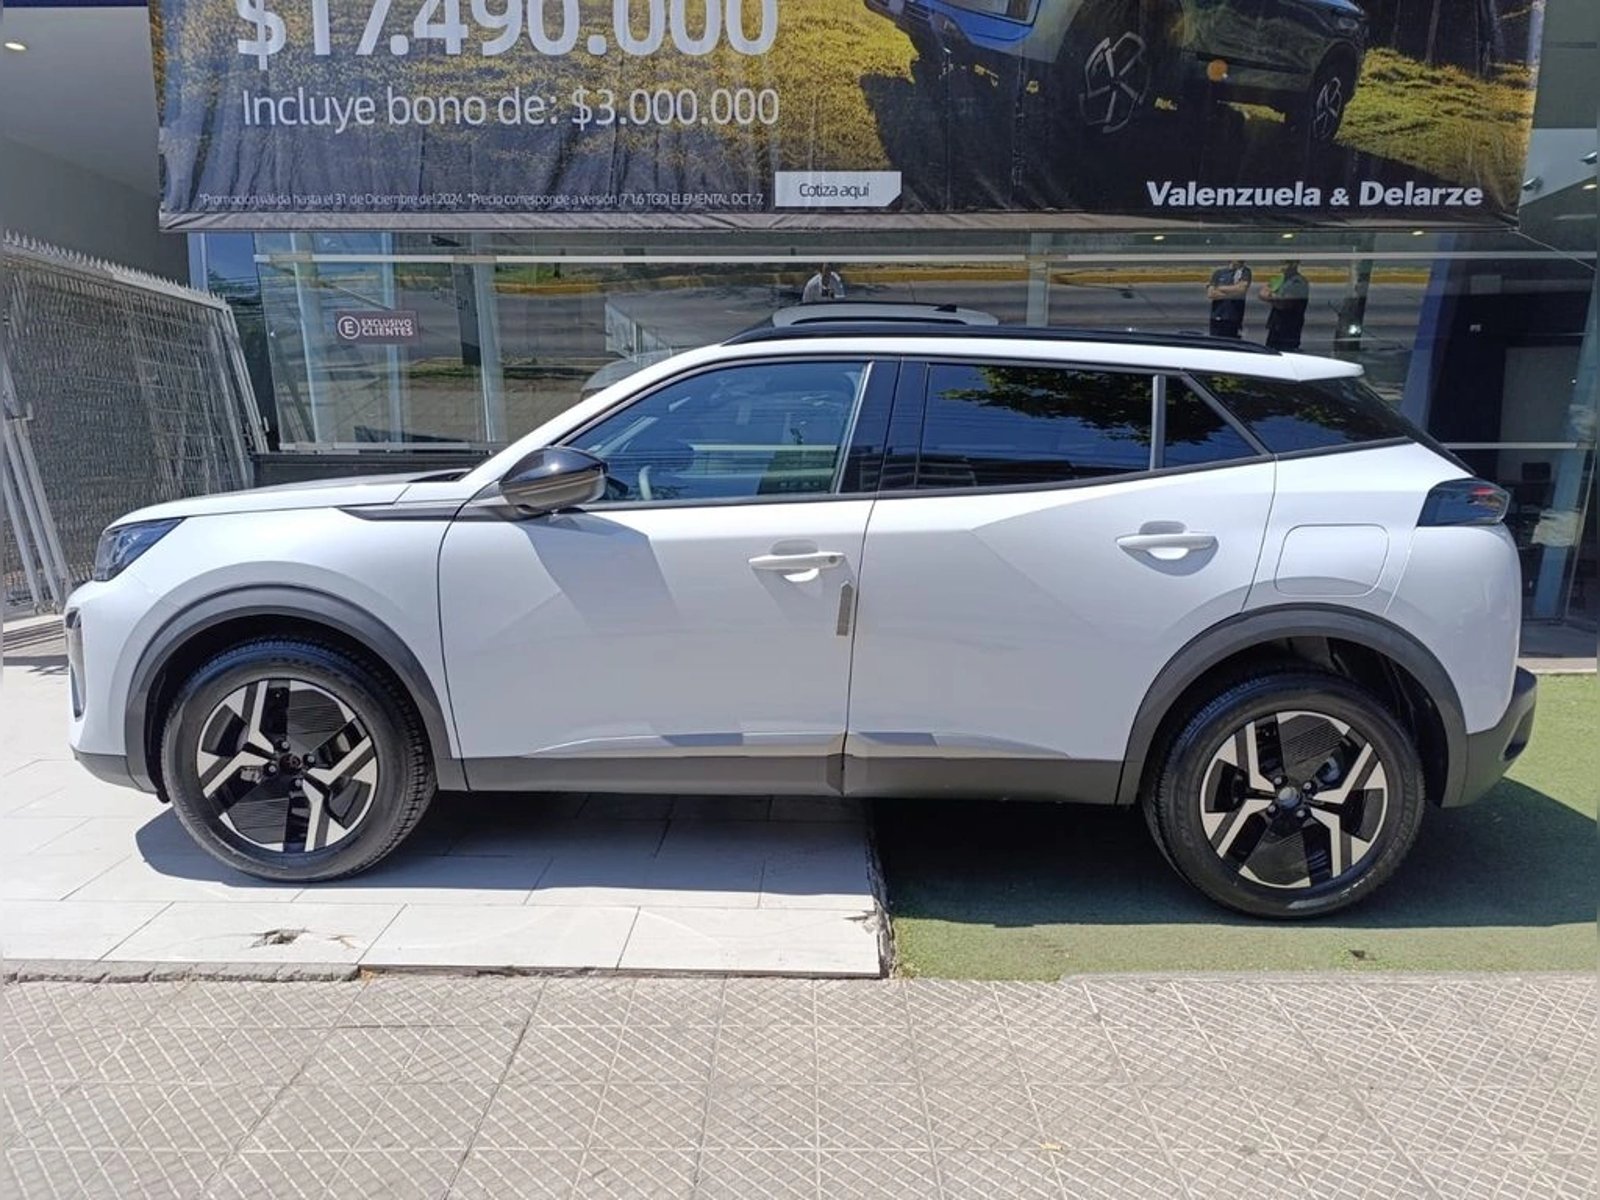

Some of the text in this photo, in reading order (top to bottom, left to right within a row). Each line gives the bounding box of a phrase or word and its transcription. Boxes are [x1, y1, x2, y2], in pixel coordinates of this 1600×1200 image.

[243, 85, 779, 134] Incluye bono de: $3.000.000
[799, 182, 870, 200] Cotiza aquí
[1147, 181, 1483, 206] Valenzuela & Delarze
[335, 193, 346, 205] 31
[350, 193, 364, 205] de
[365, 193, 418, 205] Diciembre
[419, 193, 435, 205] del
[504, 193, 570, 207] corresponde
[671, 193, 730, 205] ELEMENTAL
[361, 318, 412, 327] EXCLUSIVO
[361, 326, 413, 336] CLIENTES
